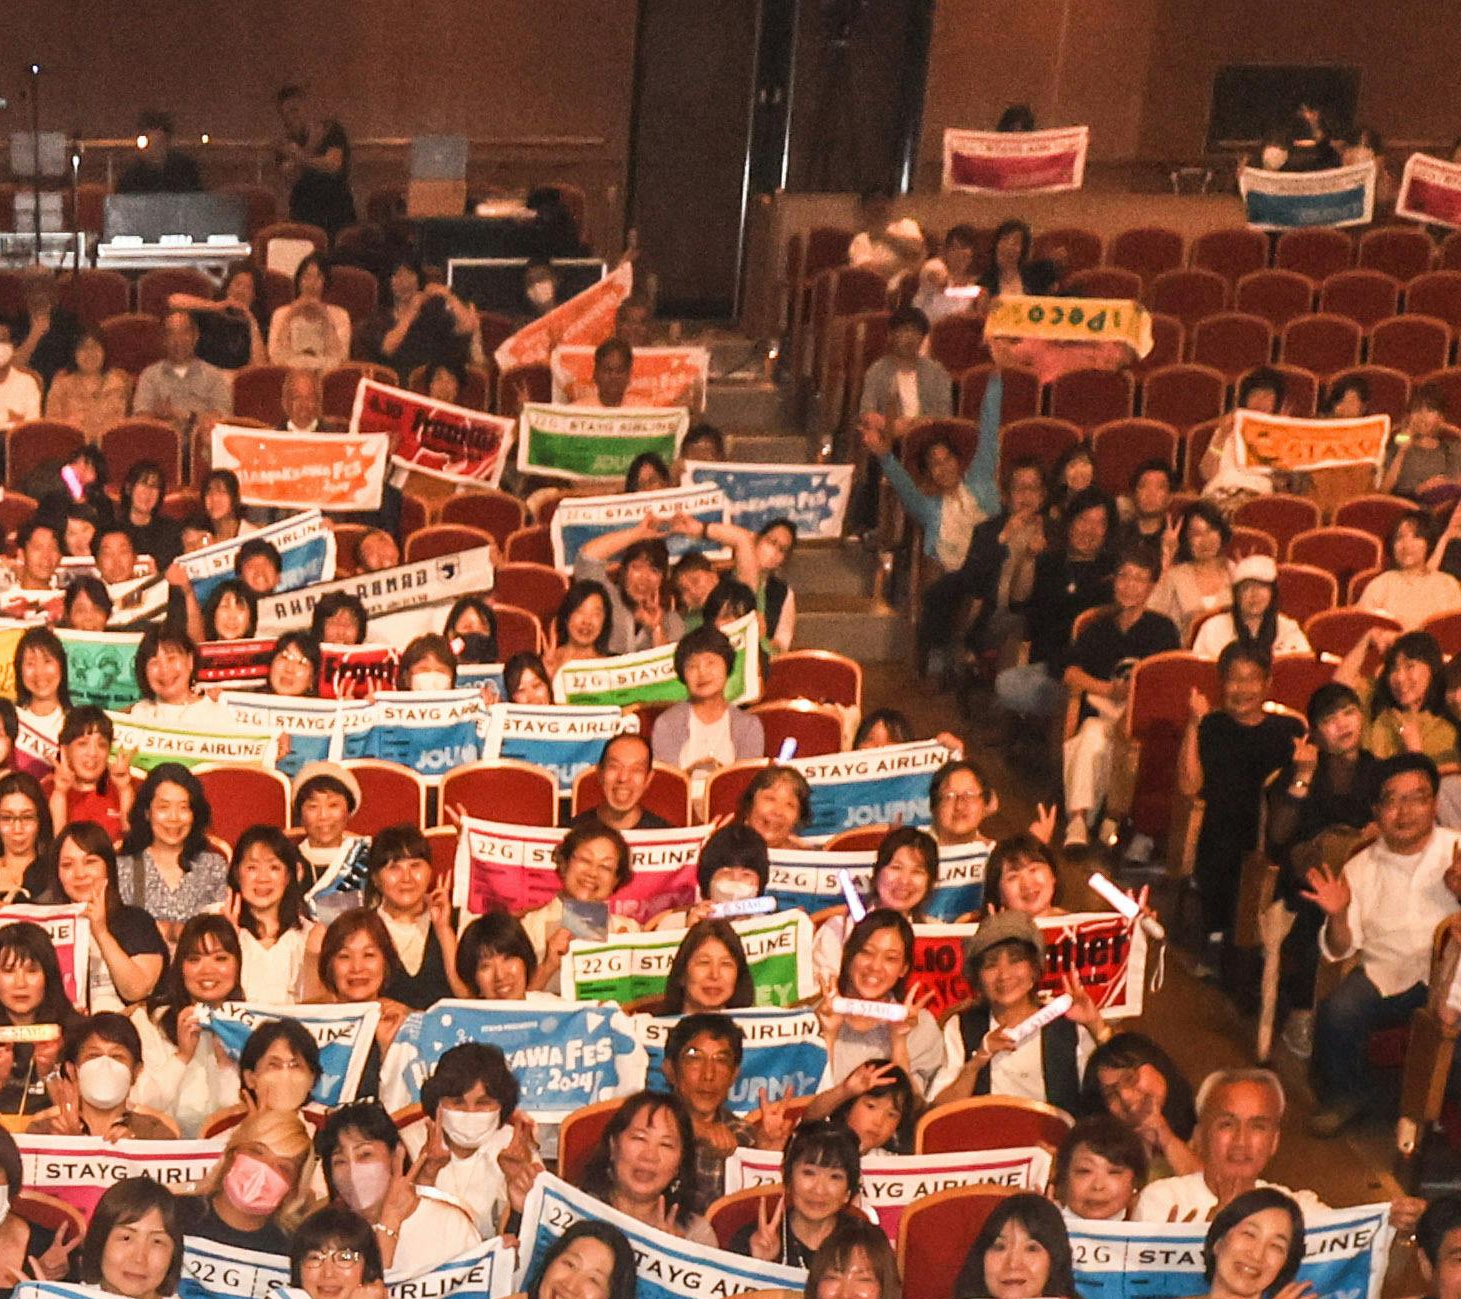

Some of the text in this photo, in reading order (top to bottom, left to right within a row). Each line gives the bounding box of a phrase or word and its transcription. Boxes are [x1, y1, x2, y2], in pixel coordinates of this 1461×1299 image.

[146, 736, 264, 756] STAYG AIRLINE
[804, 759, 867, 781] STAYG
